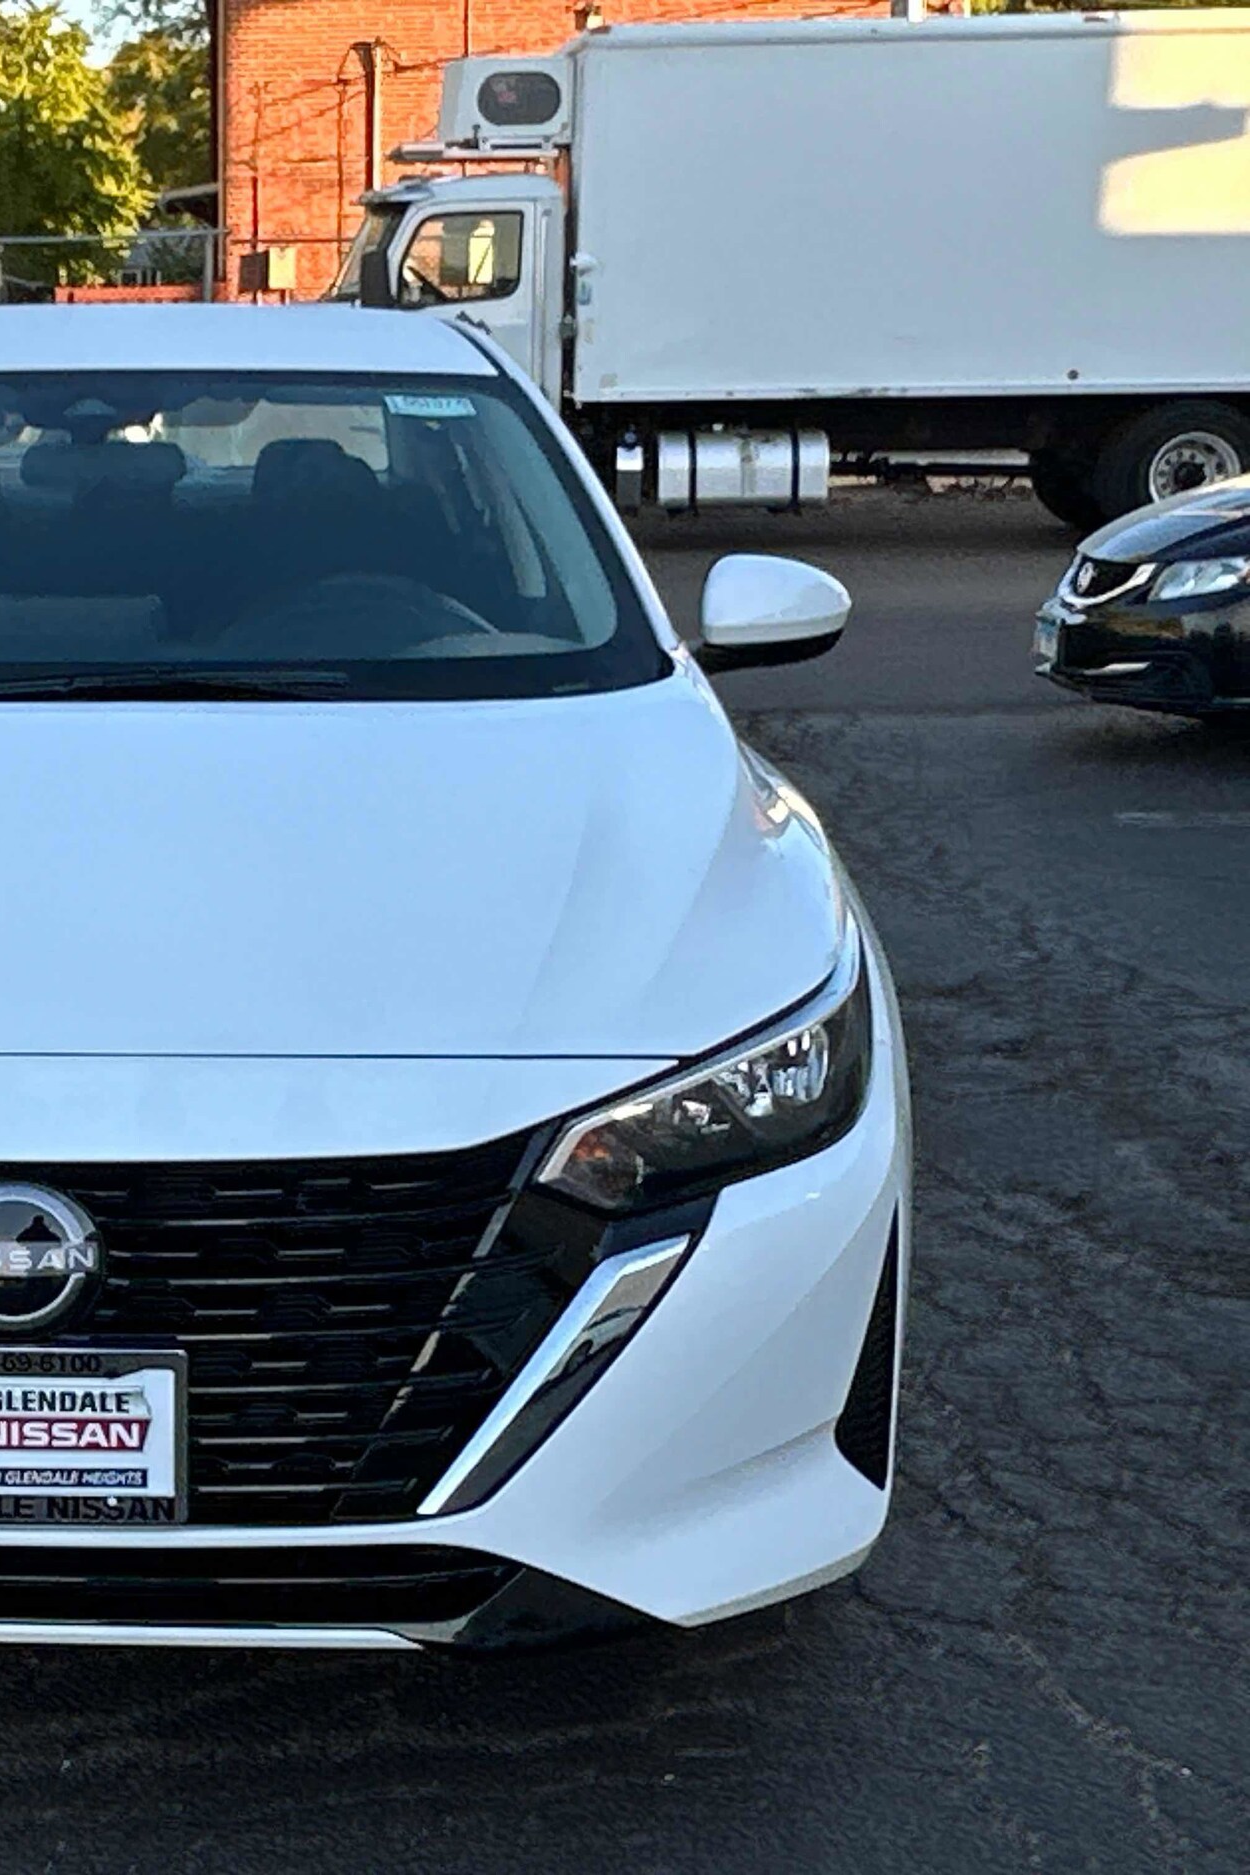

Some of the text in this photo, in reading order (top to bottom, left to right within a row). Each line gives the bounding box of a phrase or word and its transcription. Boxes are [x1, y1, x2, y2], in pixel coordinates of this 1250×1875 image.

[4, 1469, 79, 1486] GLENDALE
[81, 1470, 143, 1486] HEIGHTS
[46, 1496, 176, 1521] NISSAN
